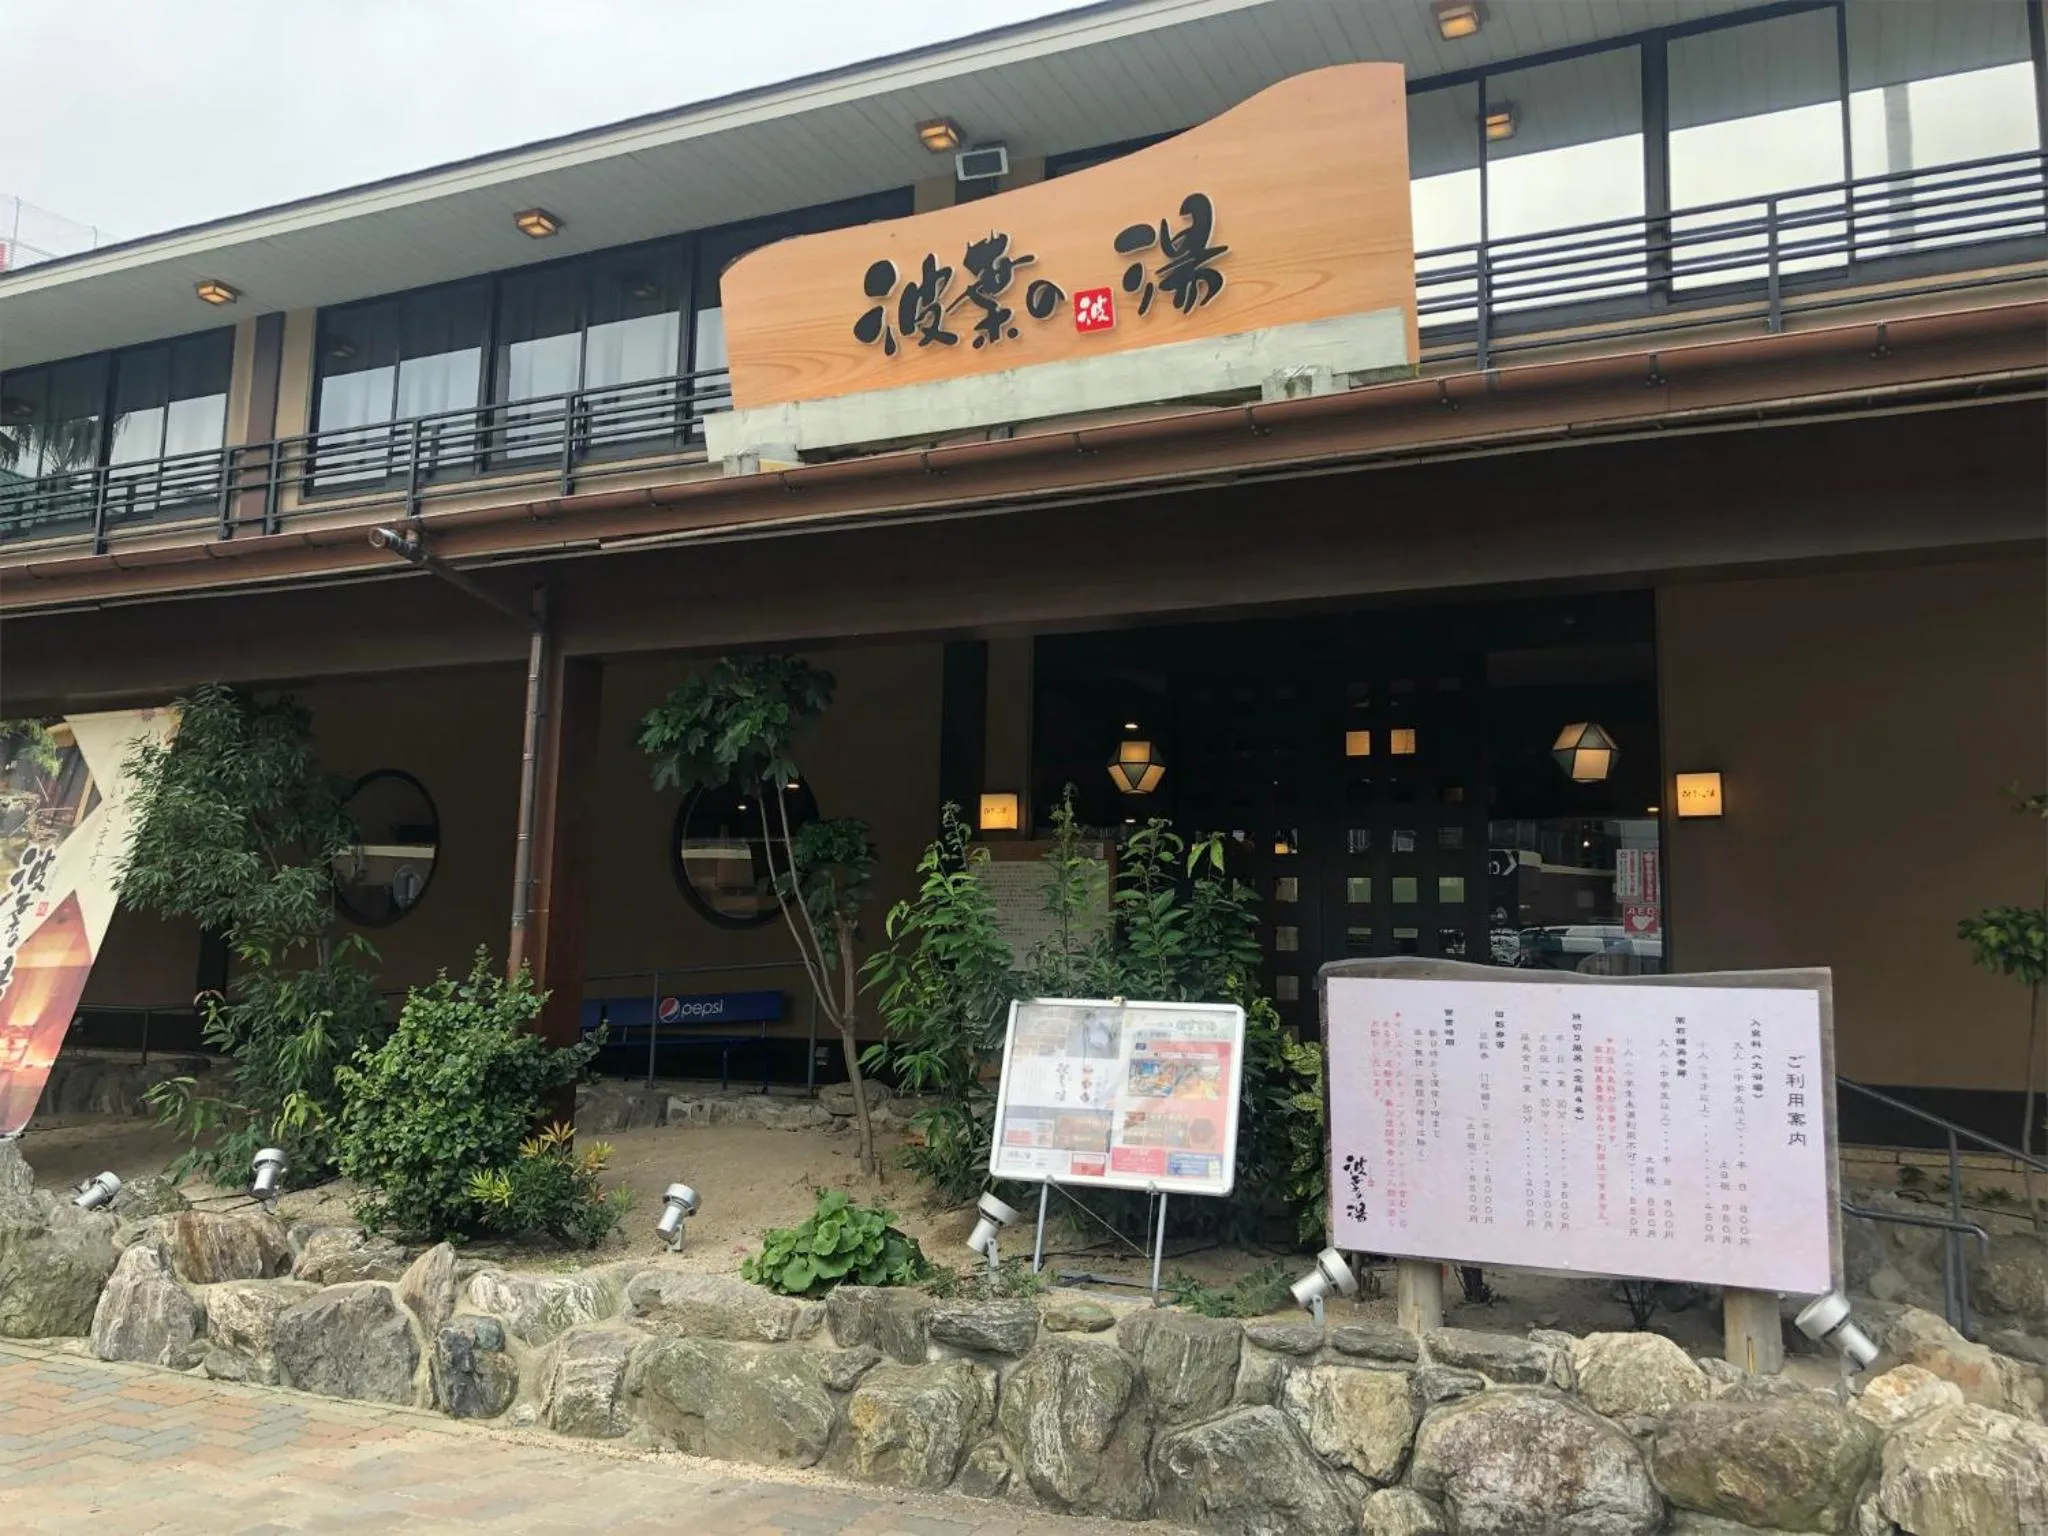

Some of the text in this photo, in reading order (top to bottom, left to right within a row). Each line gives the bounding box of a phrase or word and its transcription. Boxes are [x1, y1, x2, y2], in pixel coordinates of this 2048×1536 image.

[853, 192, 1230, 357] 波葉の湯
[1626, 906, 1656, 915] AED
[679, 999, 723, 1017] pepsi
[1785, 1054, 1807, 1146] ご利用案内
